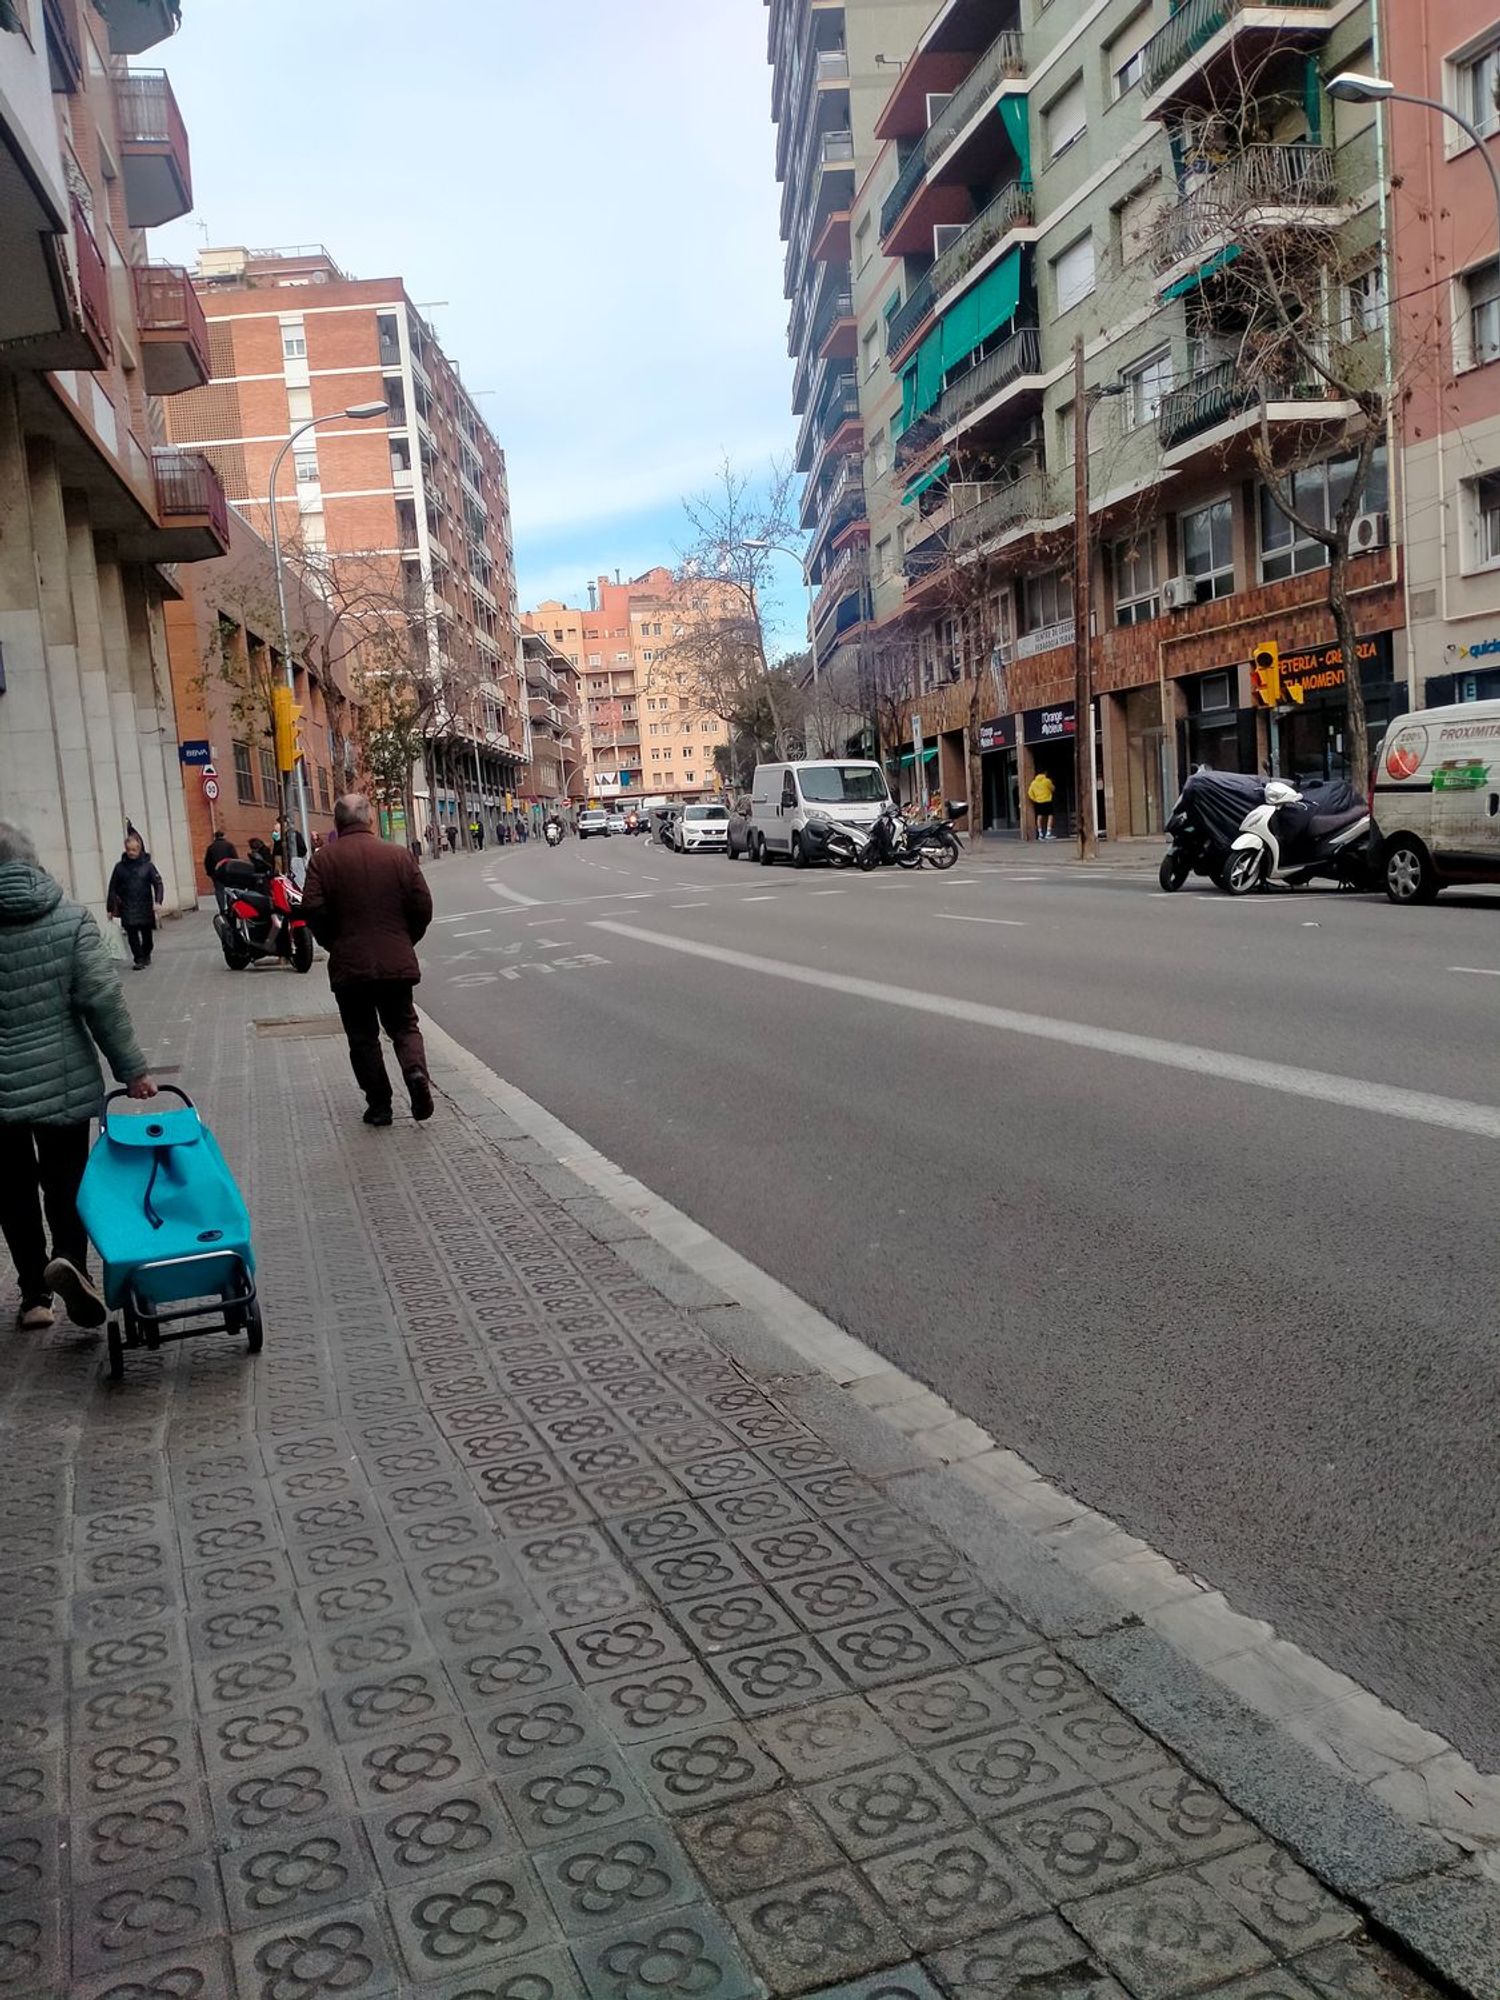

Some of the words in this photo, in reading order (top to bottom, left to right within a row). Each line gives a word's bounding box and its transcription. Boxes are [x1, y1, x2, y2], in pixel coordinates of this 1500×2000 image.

[186, 748, 208, 757] BBVA
[207, 785, 216, 794] 50
[447, 953, 613, 988] BUS
